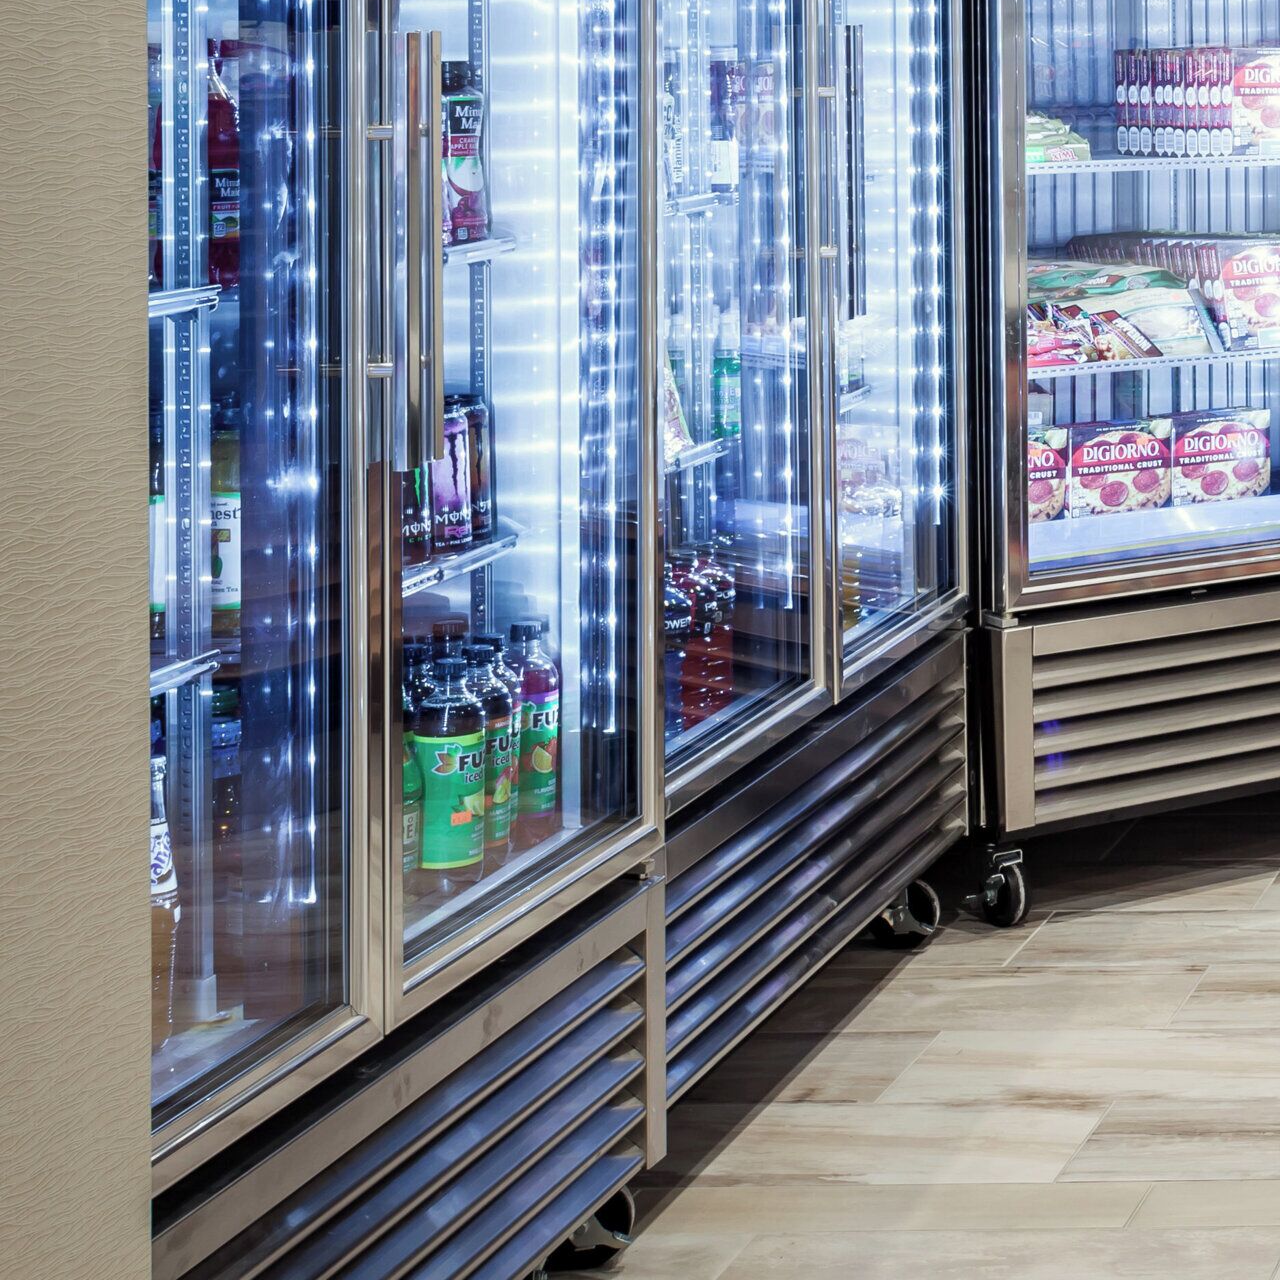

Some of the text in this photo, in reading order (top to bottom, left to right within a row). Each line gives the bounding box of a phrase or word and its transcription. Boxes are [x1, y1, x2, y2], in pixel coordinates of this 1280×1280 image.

[215, 178, 240, 187] Minu
[1083, 442, 1159, 463] DIGIORNO
[1179, 454, 1234, 465] TRADITIONAL
[1030, 470, 1057, 479] CRUST
[1078, 460, 1162, 474] TRADITIONAL CRUST
[435, 509, 472, 526] MONS
[402, 520, 431, 536] MONS
[532, 710, 558, 728] FU
[486, 735, 512, 755] FU
[459, 750, 485, 772] FU
[150, 831, 172, 886] anta
